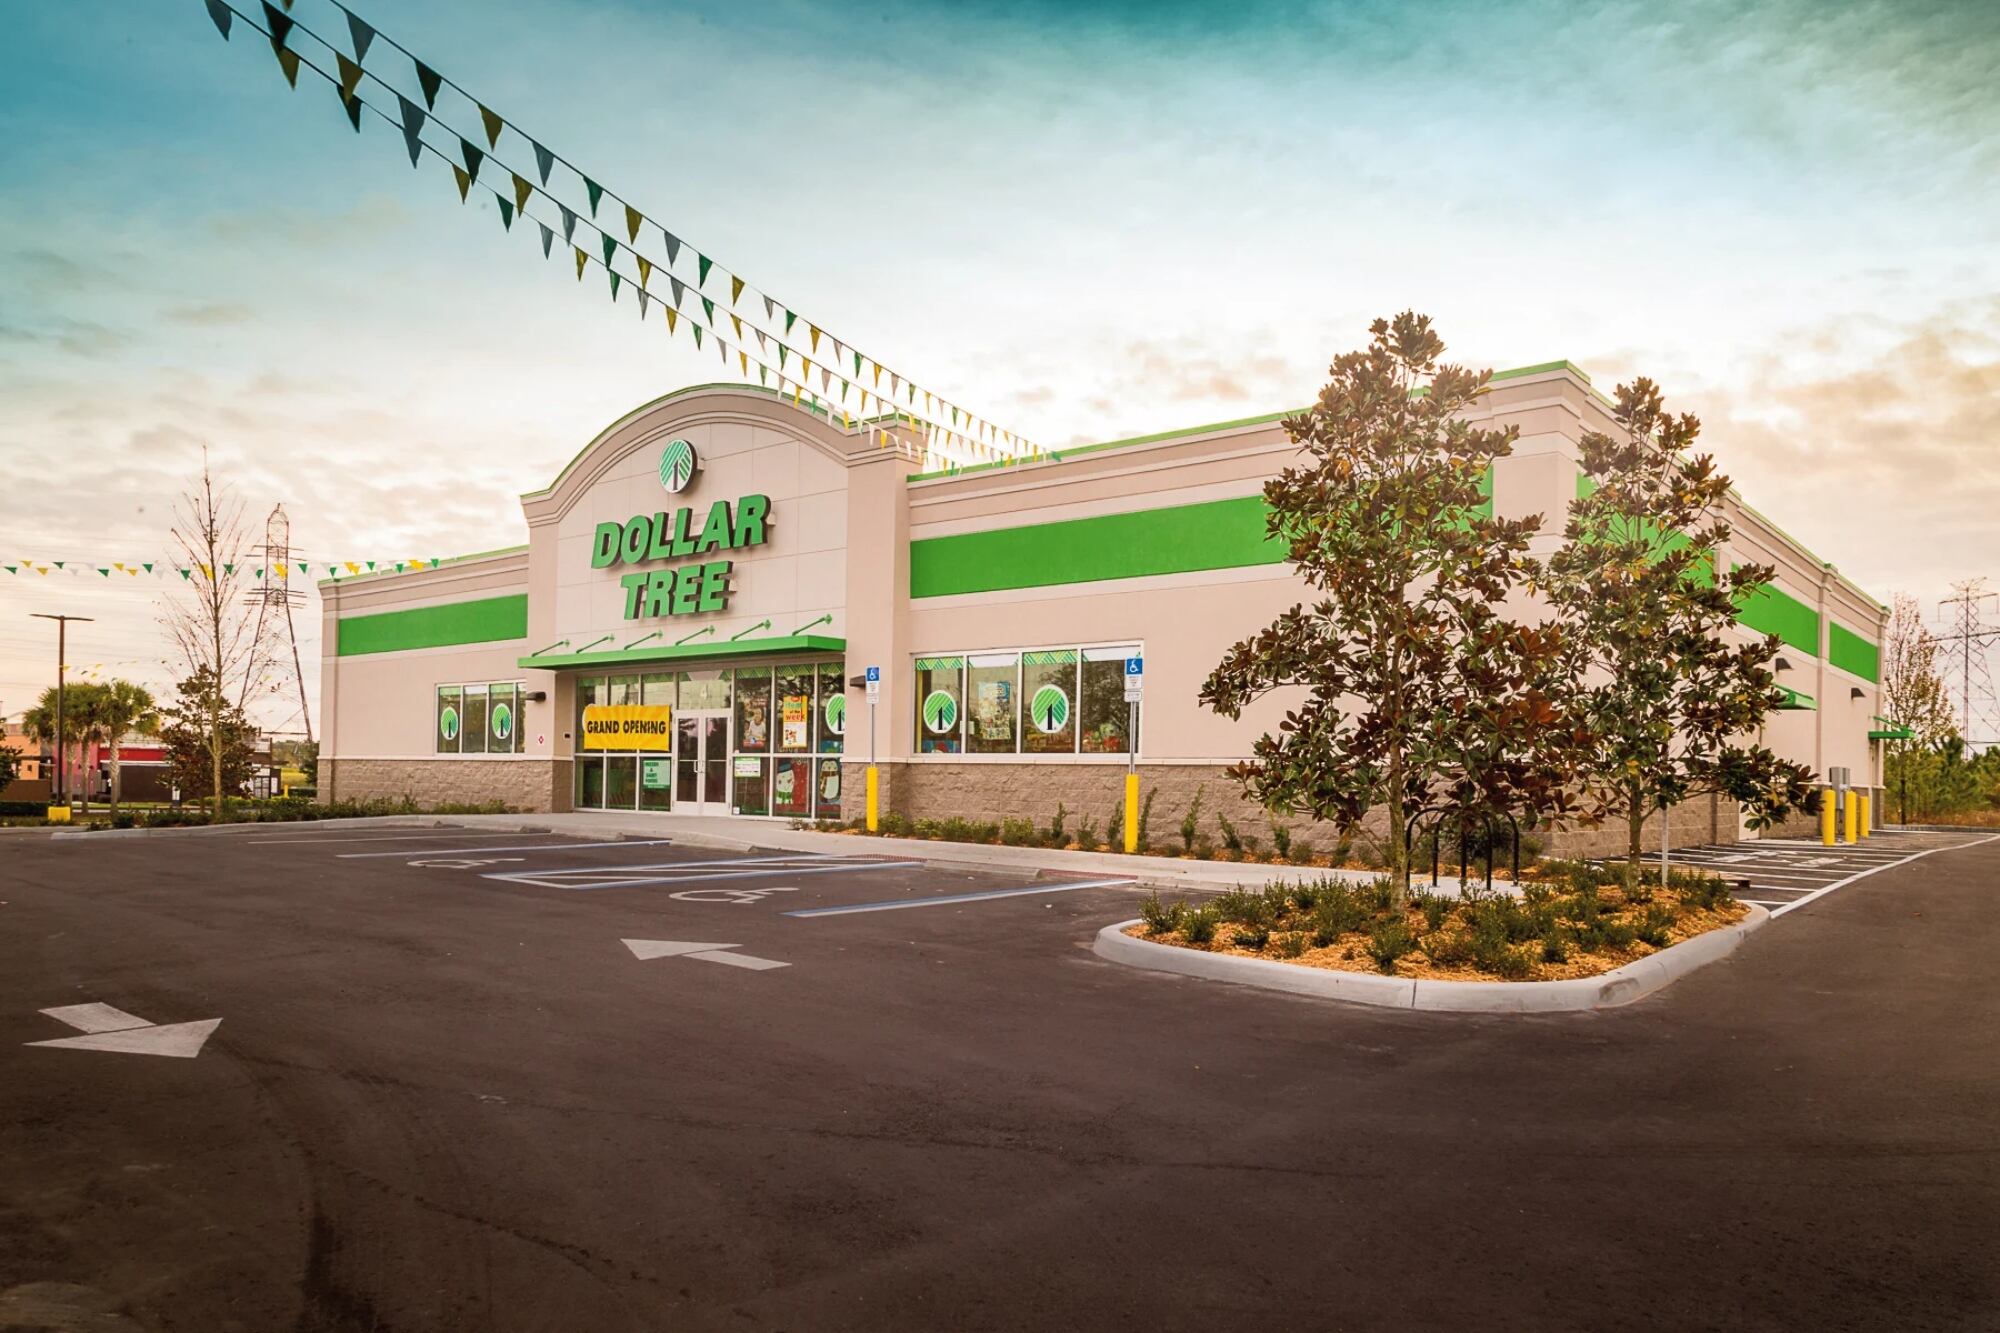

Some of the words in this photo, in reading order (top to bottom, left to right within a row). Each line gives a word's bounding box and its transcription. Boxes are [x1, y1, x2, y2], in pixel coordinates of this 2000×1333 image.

[591, 494, 771, 569] DOLLAR
[621, 561, 733, 620] TREE
[587, 720, 619, 734] GRAND
[622, 720, 666, 735] OPENING
